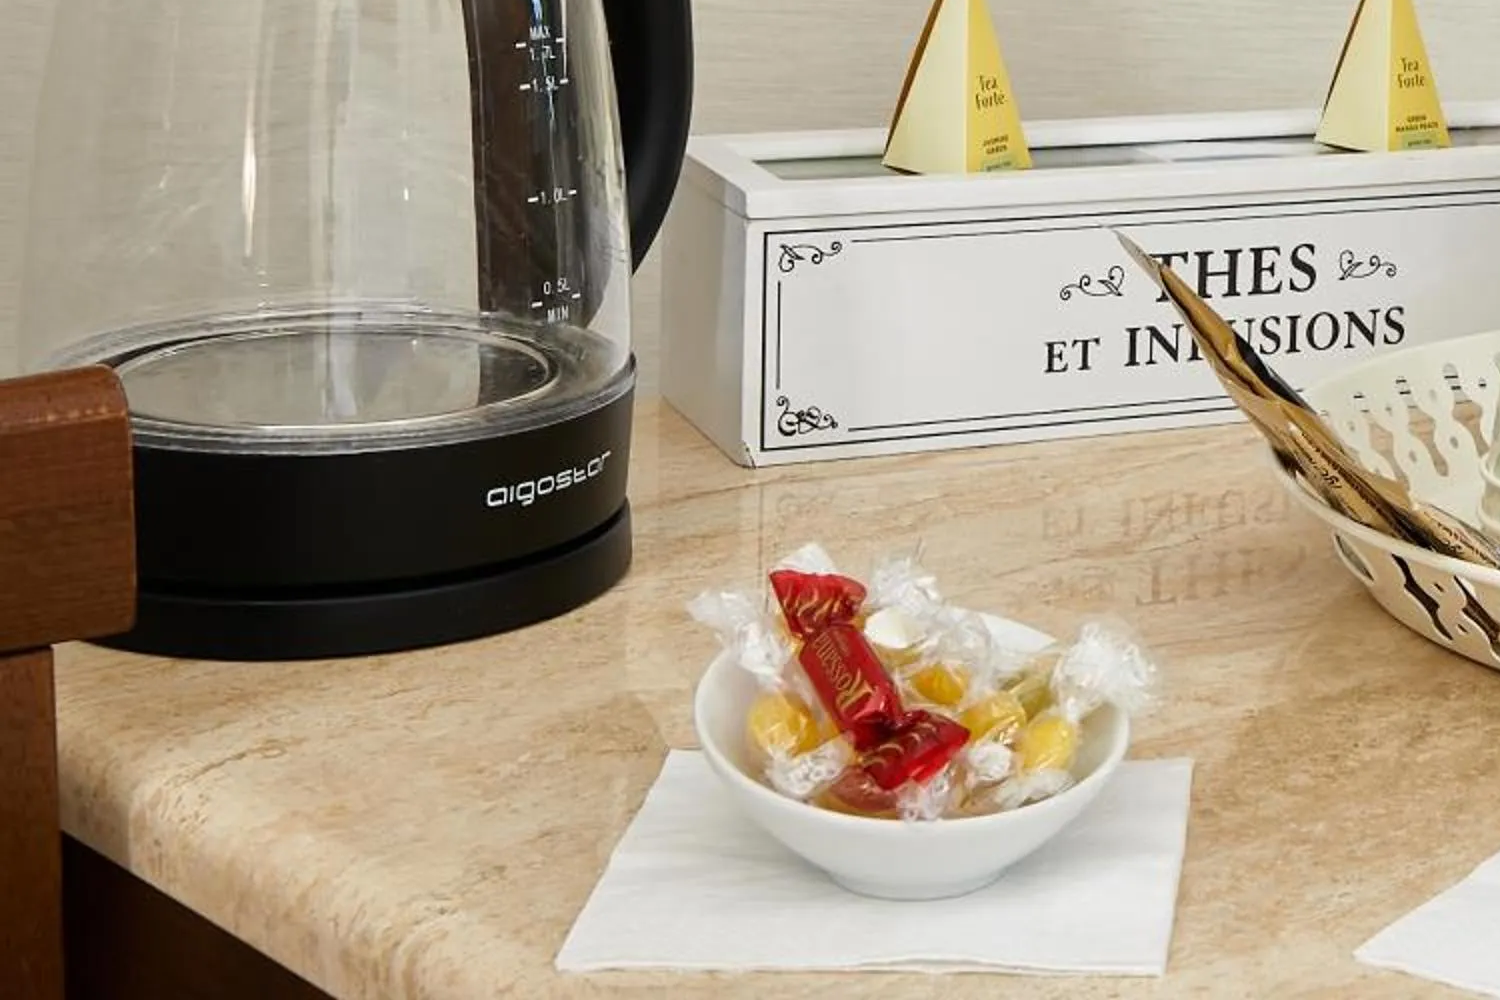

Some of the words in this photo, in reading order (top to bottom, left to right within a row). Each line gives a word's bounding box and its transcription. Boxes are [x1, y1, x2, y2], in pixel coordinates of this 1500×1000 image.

[1400, 57, 1420, 72] Tea
[977, 74, 998, 91] Tea
[1149, 243, 1317, 303] THES
[543, 277, 571, 295] 0.5L
[547, 304, 569, 322] MIN
[1044, 336, 1101, 374] ET
[1124, 305, 1406, 367] INSIONS
[486, 449, 612, 507] aigostar
